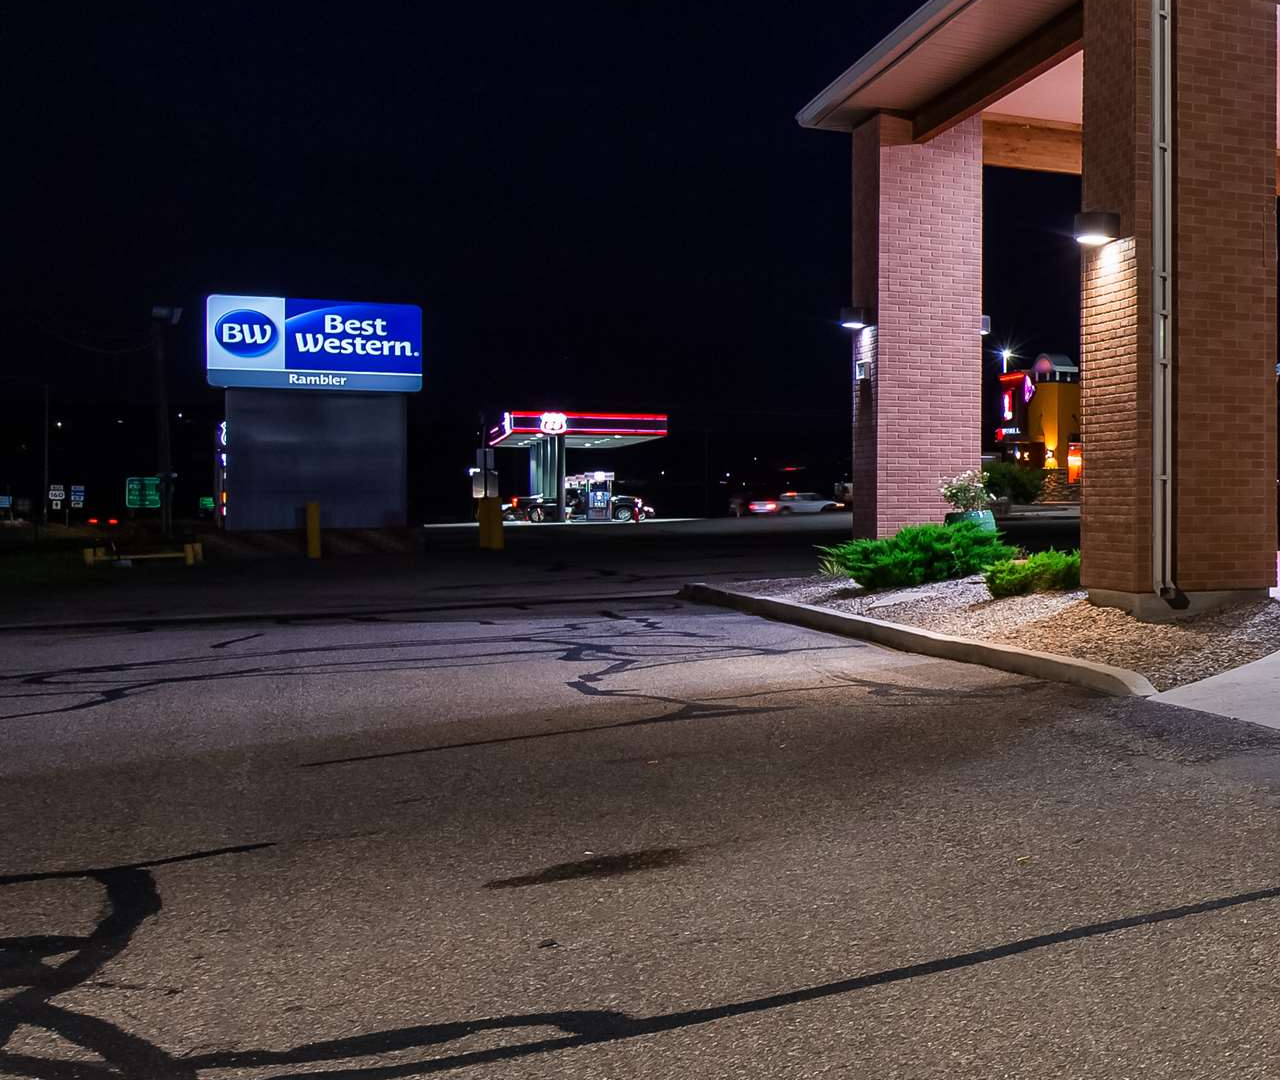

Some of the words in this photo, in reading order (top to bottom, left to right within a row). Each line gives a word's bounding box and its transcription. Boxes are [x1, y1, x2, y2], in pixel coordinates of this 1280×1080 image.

[222, 323, 272, 345] BW
[325, 315, 387, 336] Best
[289, 374, 347, 385] Rambler
